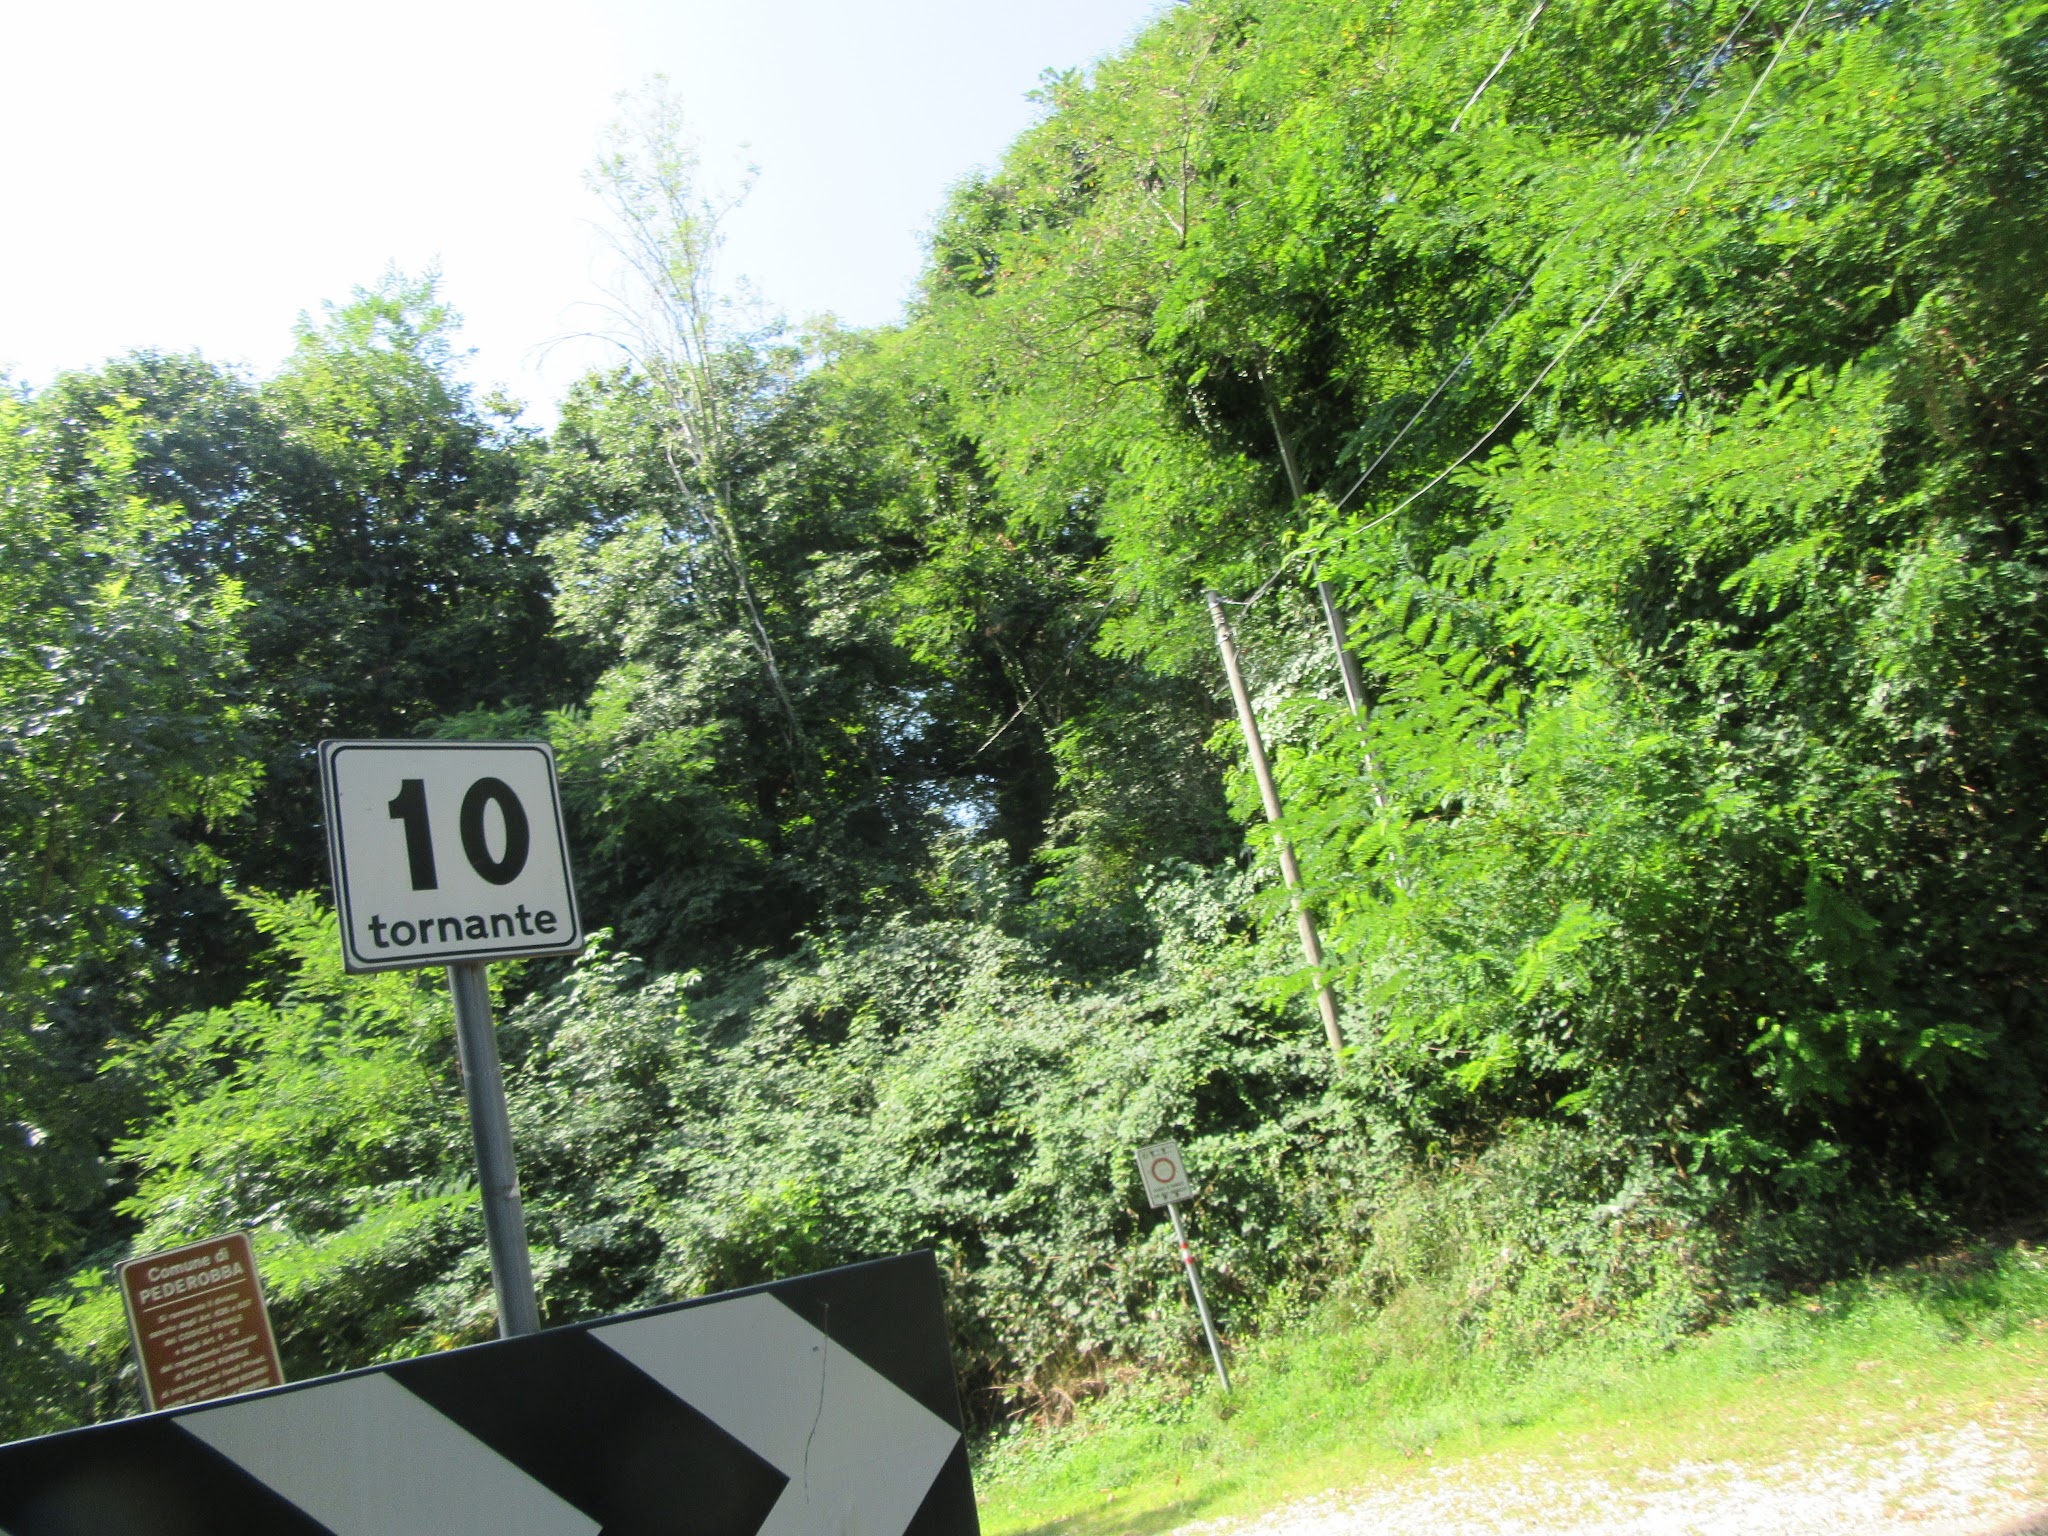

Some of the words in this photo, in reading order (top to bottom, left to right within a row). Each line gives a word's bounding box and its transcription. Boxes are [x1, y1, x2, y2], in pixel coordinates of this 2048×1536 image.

[388, 776, 530, 891] 10
[368, 904, 557, 948] tornante
[140, 1262, 244, 1304] PEDEROBBA
[148, 1256, 211, 1281] Comune
[214, 1247, 229, 1262] di
